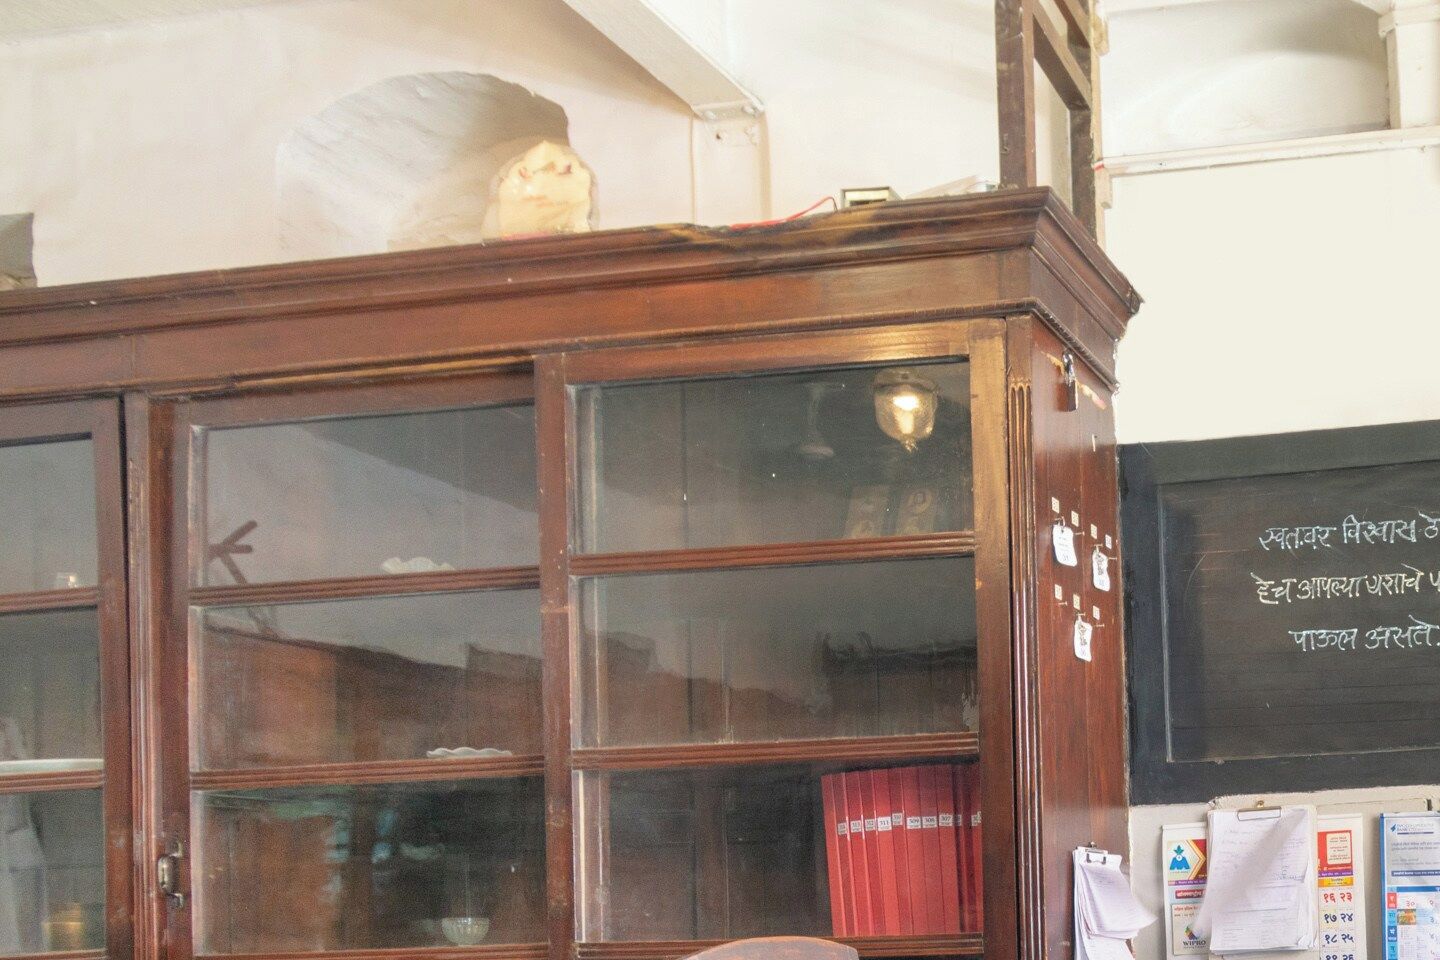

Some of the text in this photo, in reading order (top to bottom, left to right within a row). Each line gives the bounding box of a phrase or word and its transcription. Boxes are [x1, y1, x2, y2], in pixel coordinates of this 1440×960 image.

[1323, 891, 1353, 904] १६ २३
[1324, 912, 1354, 924] १७ २४
[1325, 933, 1354, 944] १८ २५
